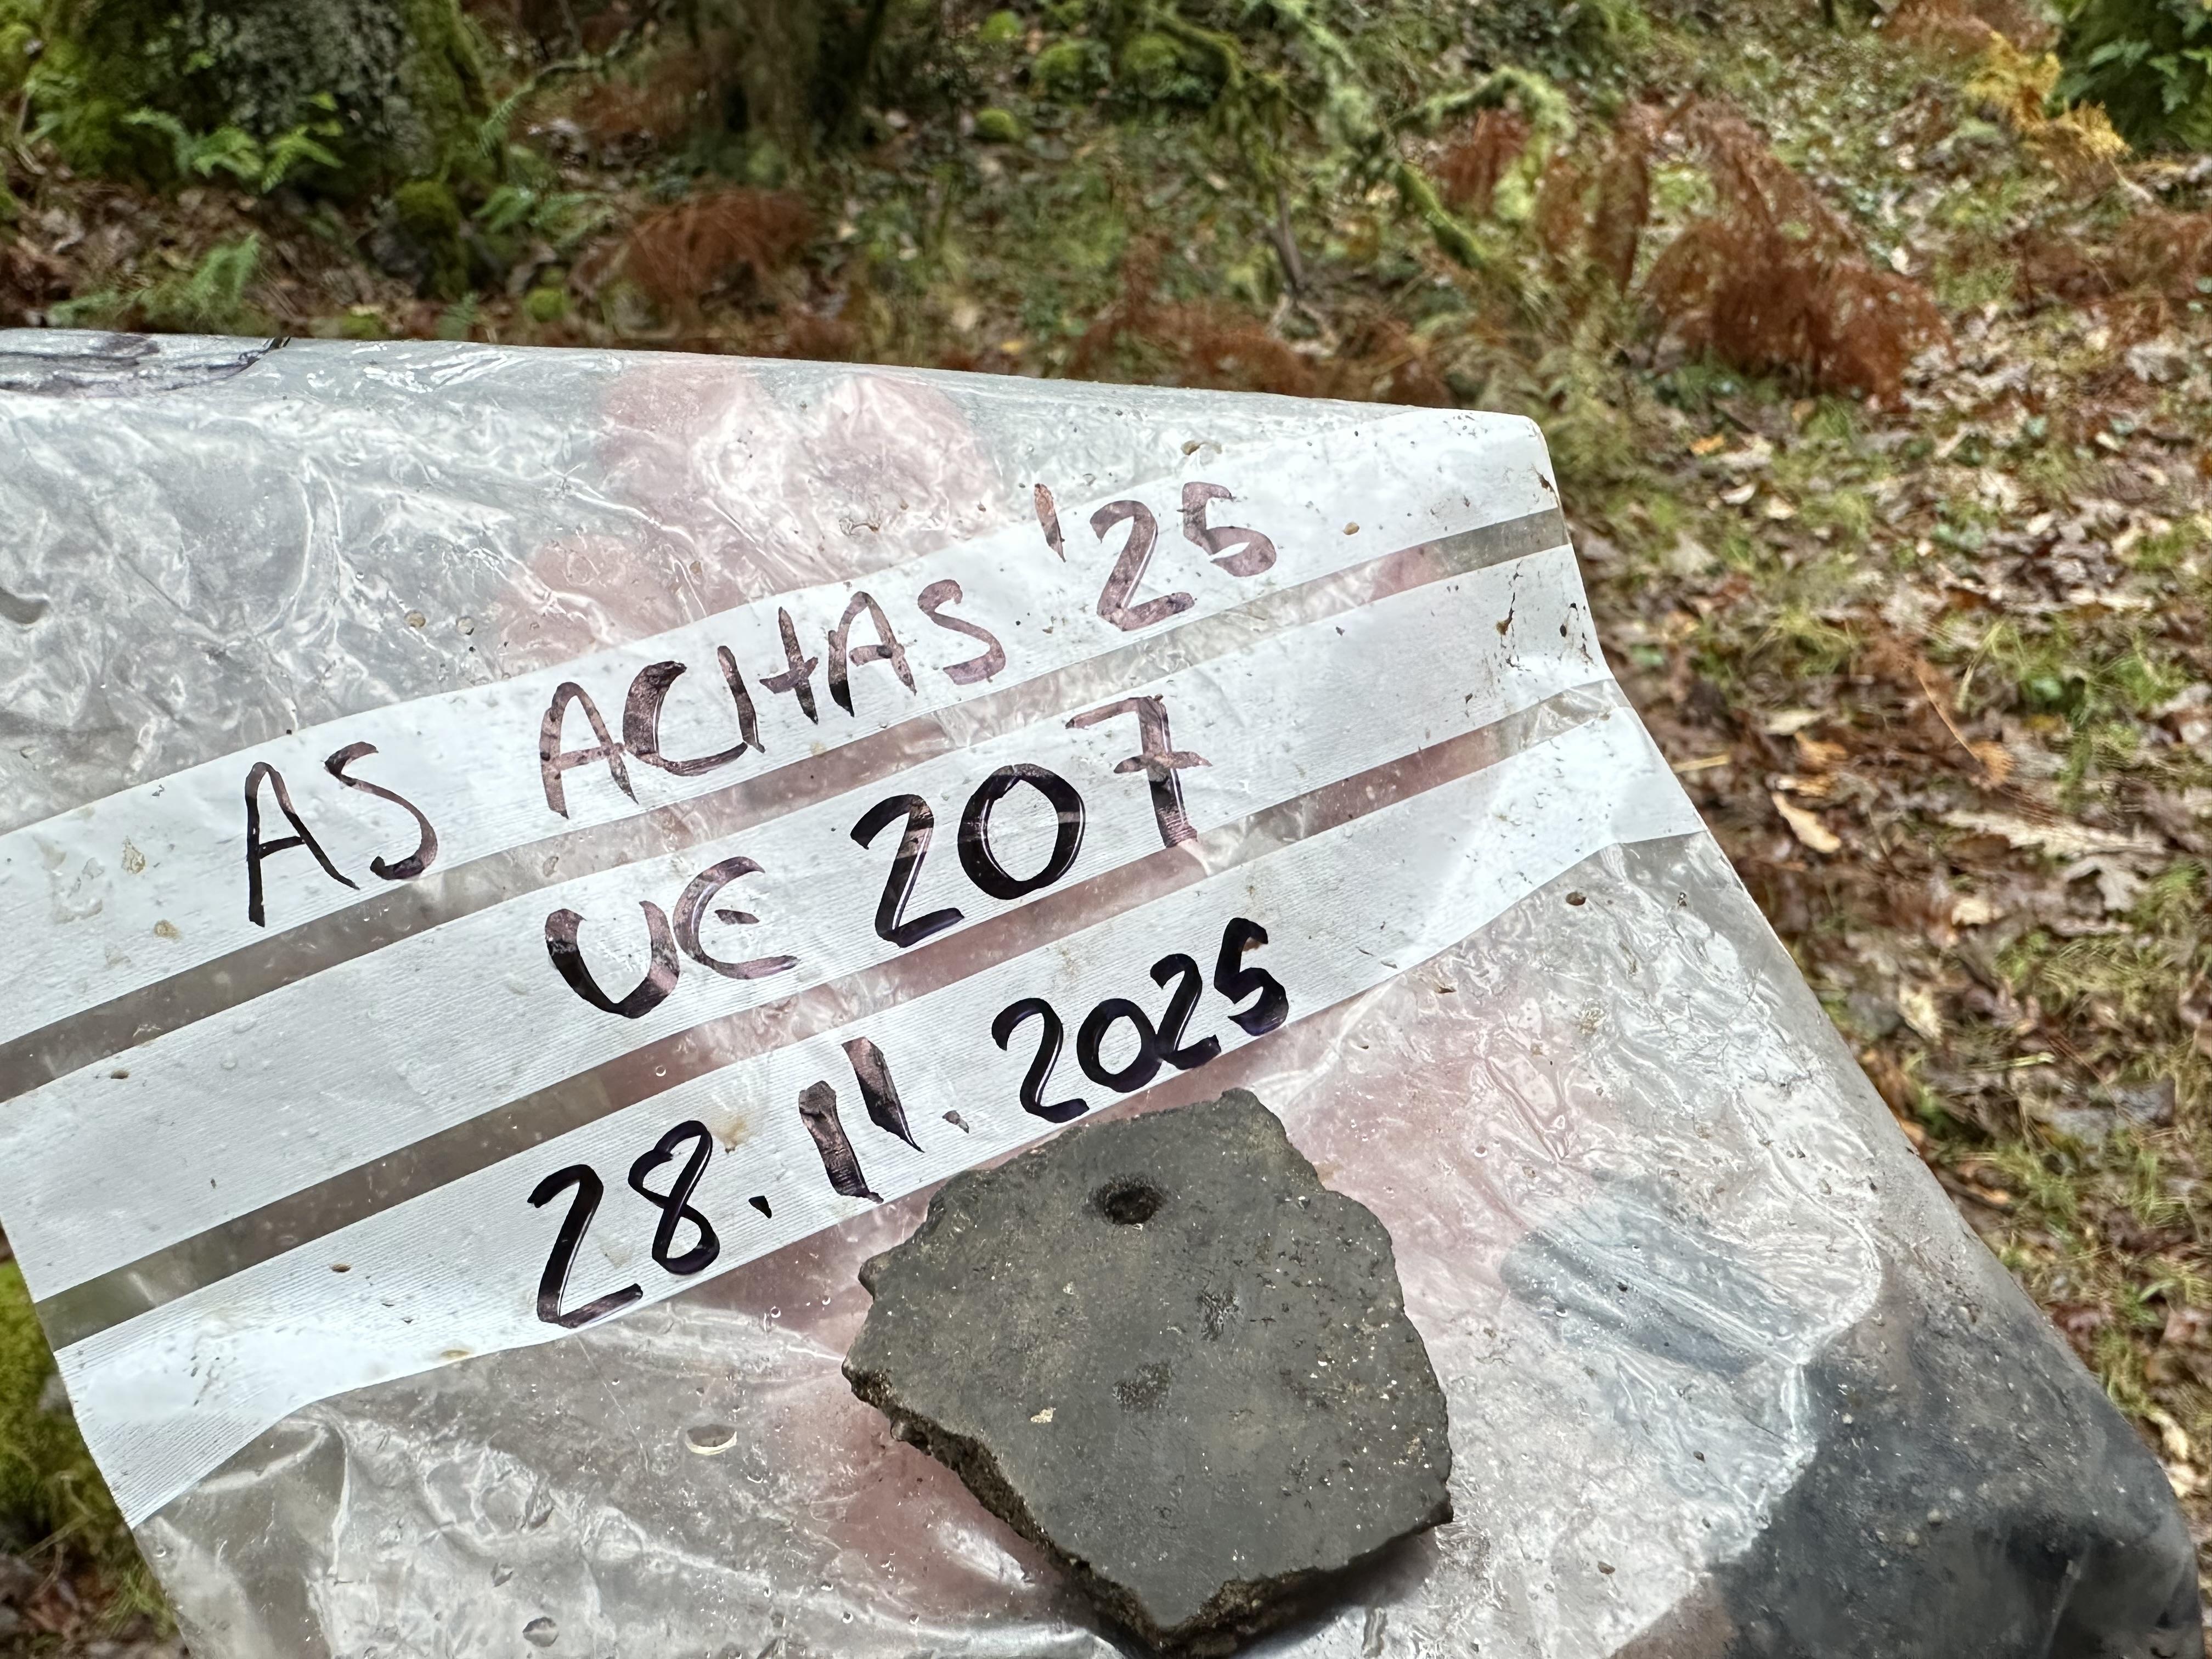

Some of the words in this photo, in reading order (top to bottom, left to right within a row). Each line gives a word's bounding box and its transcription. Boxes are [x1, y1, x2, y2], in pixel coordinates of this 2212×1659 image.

[245, 741, 437, 928] AS
[539, 579, 1007, 820] ACHAS
[1034, 481, 1277, 631] '25
[545, 856, 802, 1019] UE
[850, 695, 1212, 948] 207
[527, 917, 1289, 1329] 28.11.2025
